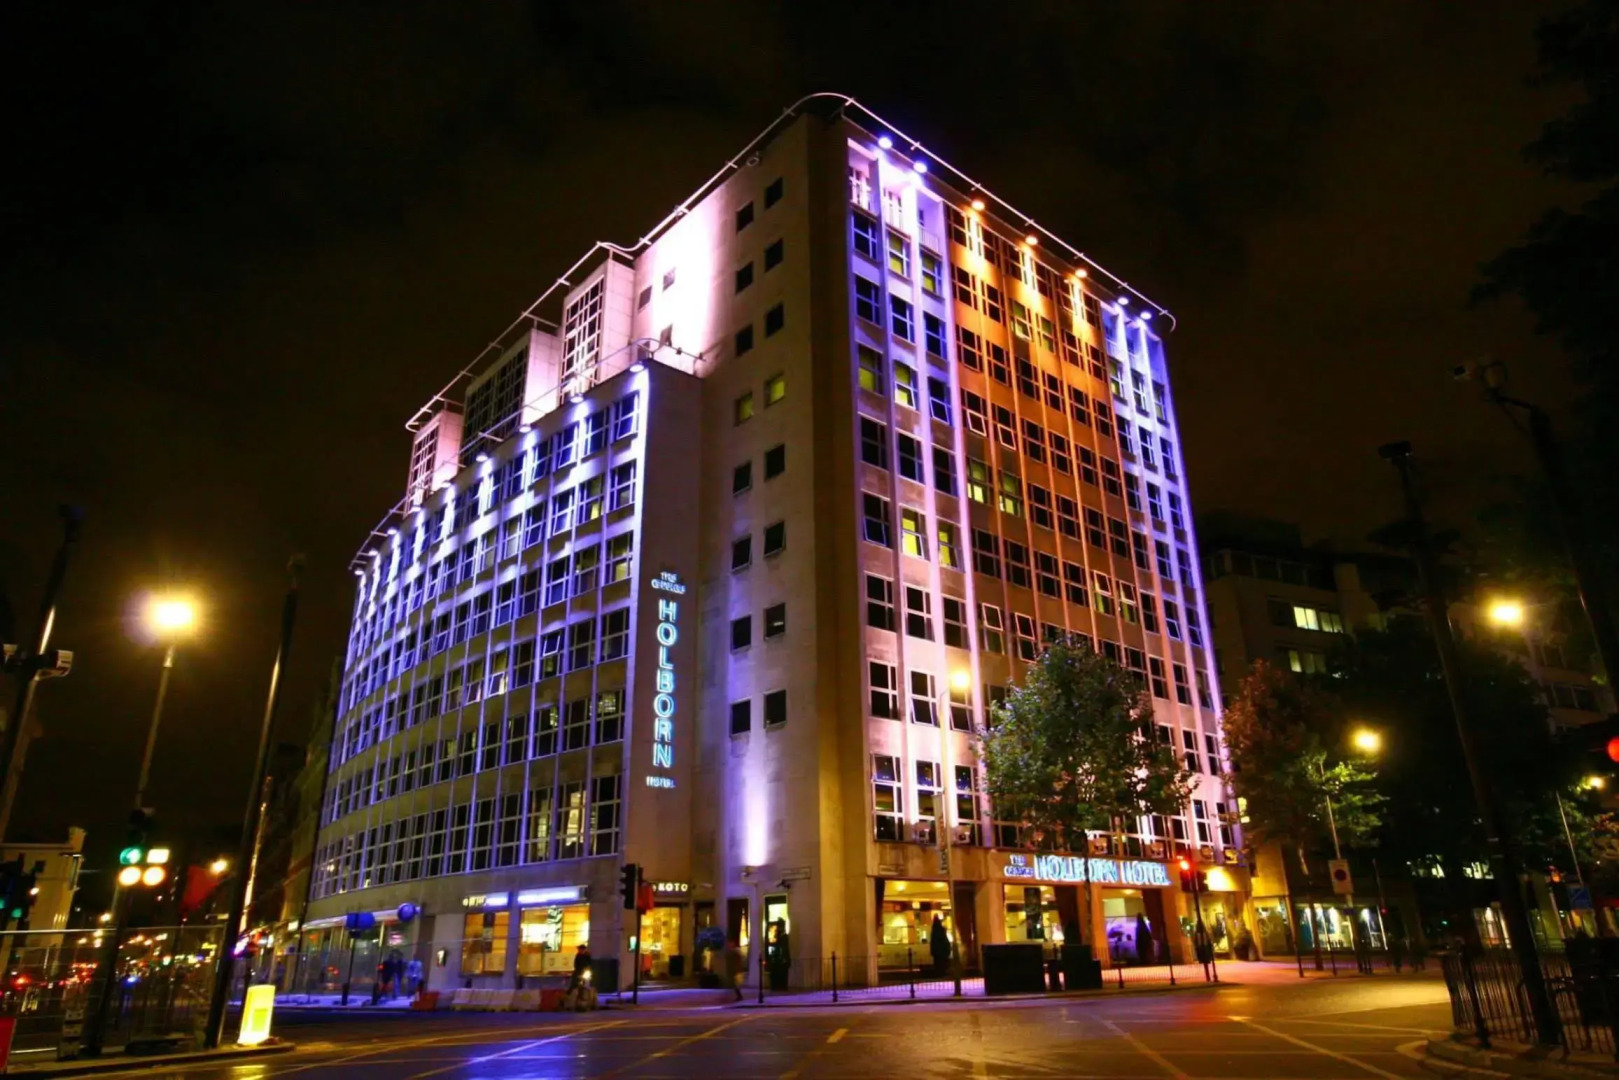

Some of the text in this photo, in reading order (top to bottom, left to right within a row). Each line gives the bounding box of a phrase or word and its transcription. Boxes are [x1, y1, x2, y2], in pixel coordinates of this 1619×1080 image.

[653, 599, 677, 768] HOLBORN
[1034, 855, 1172, 886] HOLBORN HOTEL
[658, 883, 688, 892] KOTO
